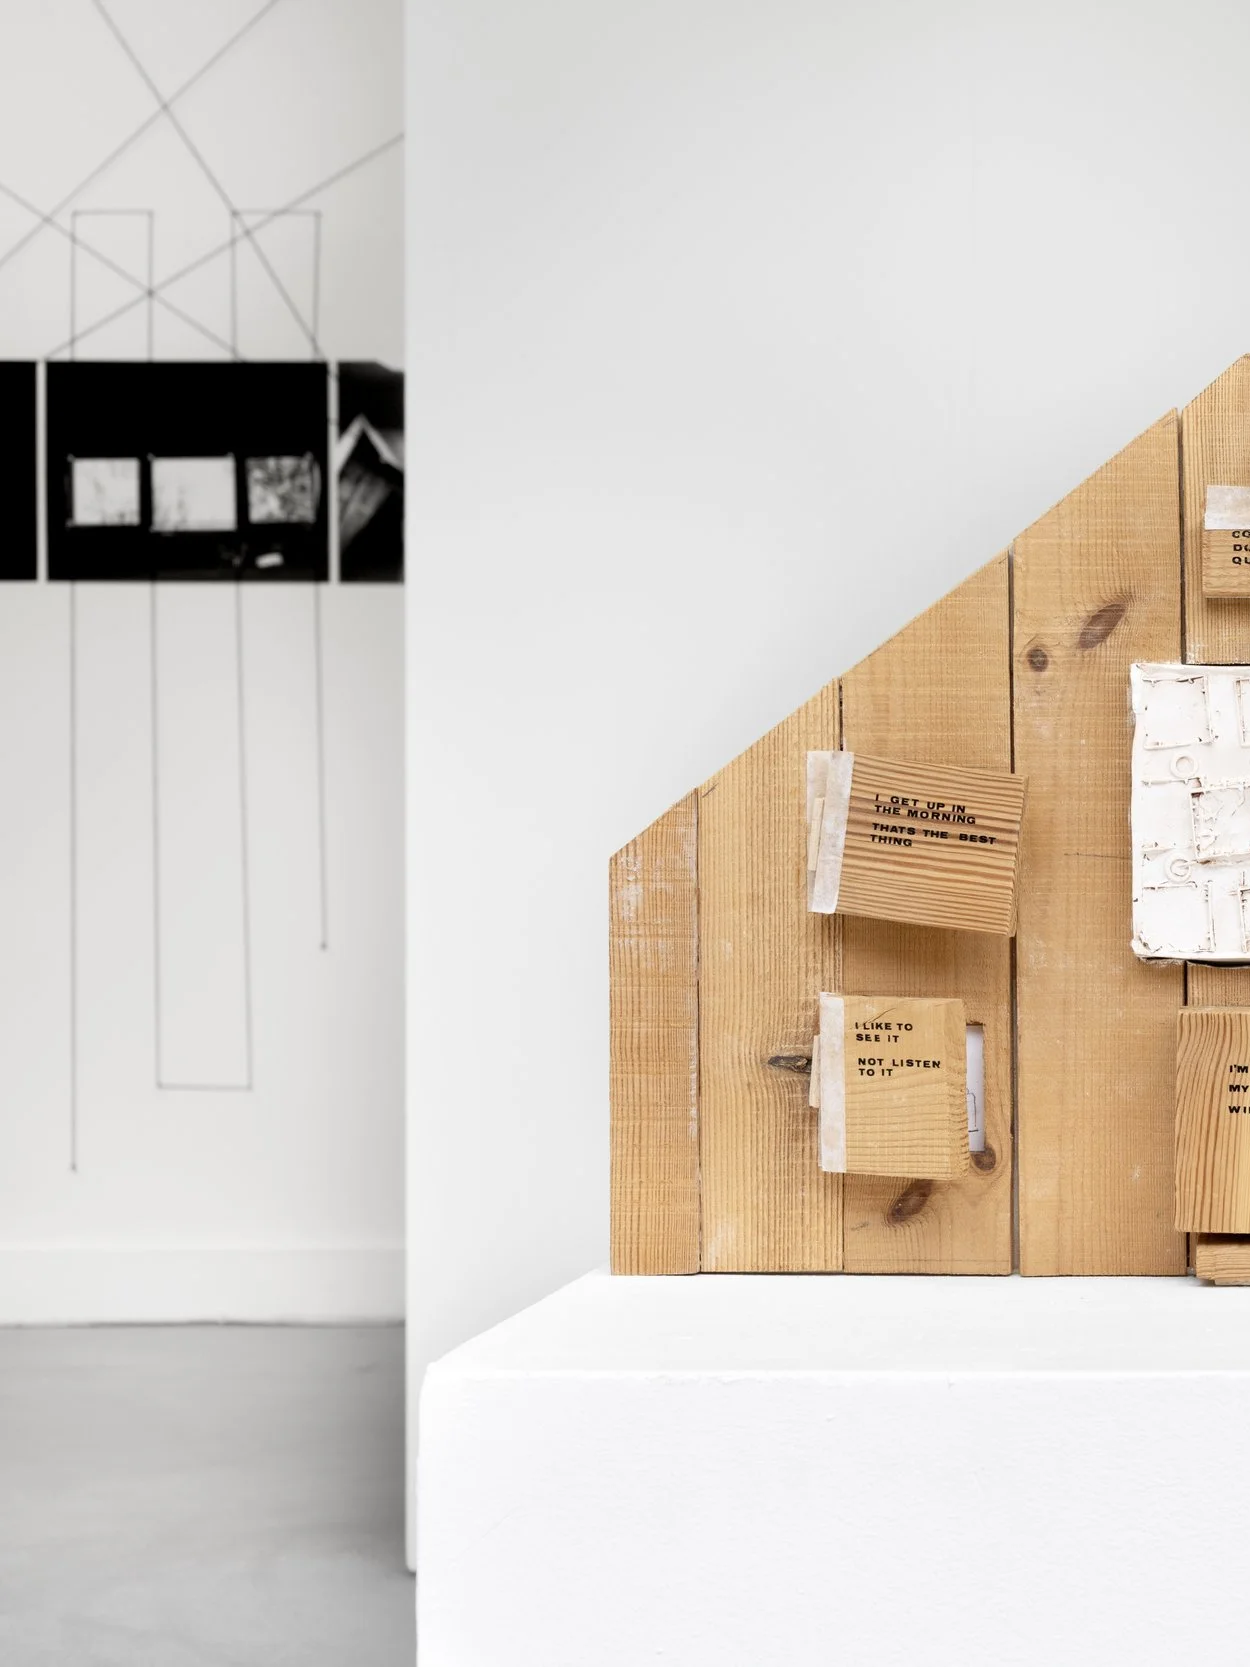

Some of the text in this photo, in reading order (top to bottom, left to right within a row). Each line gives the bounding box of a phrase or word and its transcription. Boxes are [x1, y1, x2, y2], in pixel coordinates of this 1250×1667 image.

[874, 793, 966, 816] I GET UP IN
[874, 803, 977, 825] THE MORNING
[872, 823, 999, 845] THATS THE BEST
[869, 834, 913, 847] THING
[855, 1021, 913, 1032] I LIKE TO
[855, 1033, 900, 1043] SEE IT
[858, 1057, 941, 1069] NOT LISTEN
[858, 1068, 893, 1077] TO IT
[1229, 1064, 1249, 1074] I'M
[1228, 1084, 1250, 1093] MY
